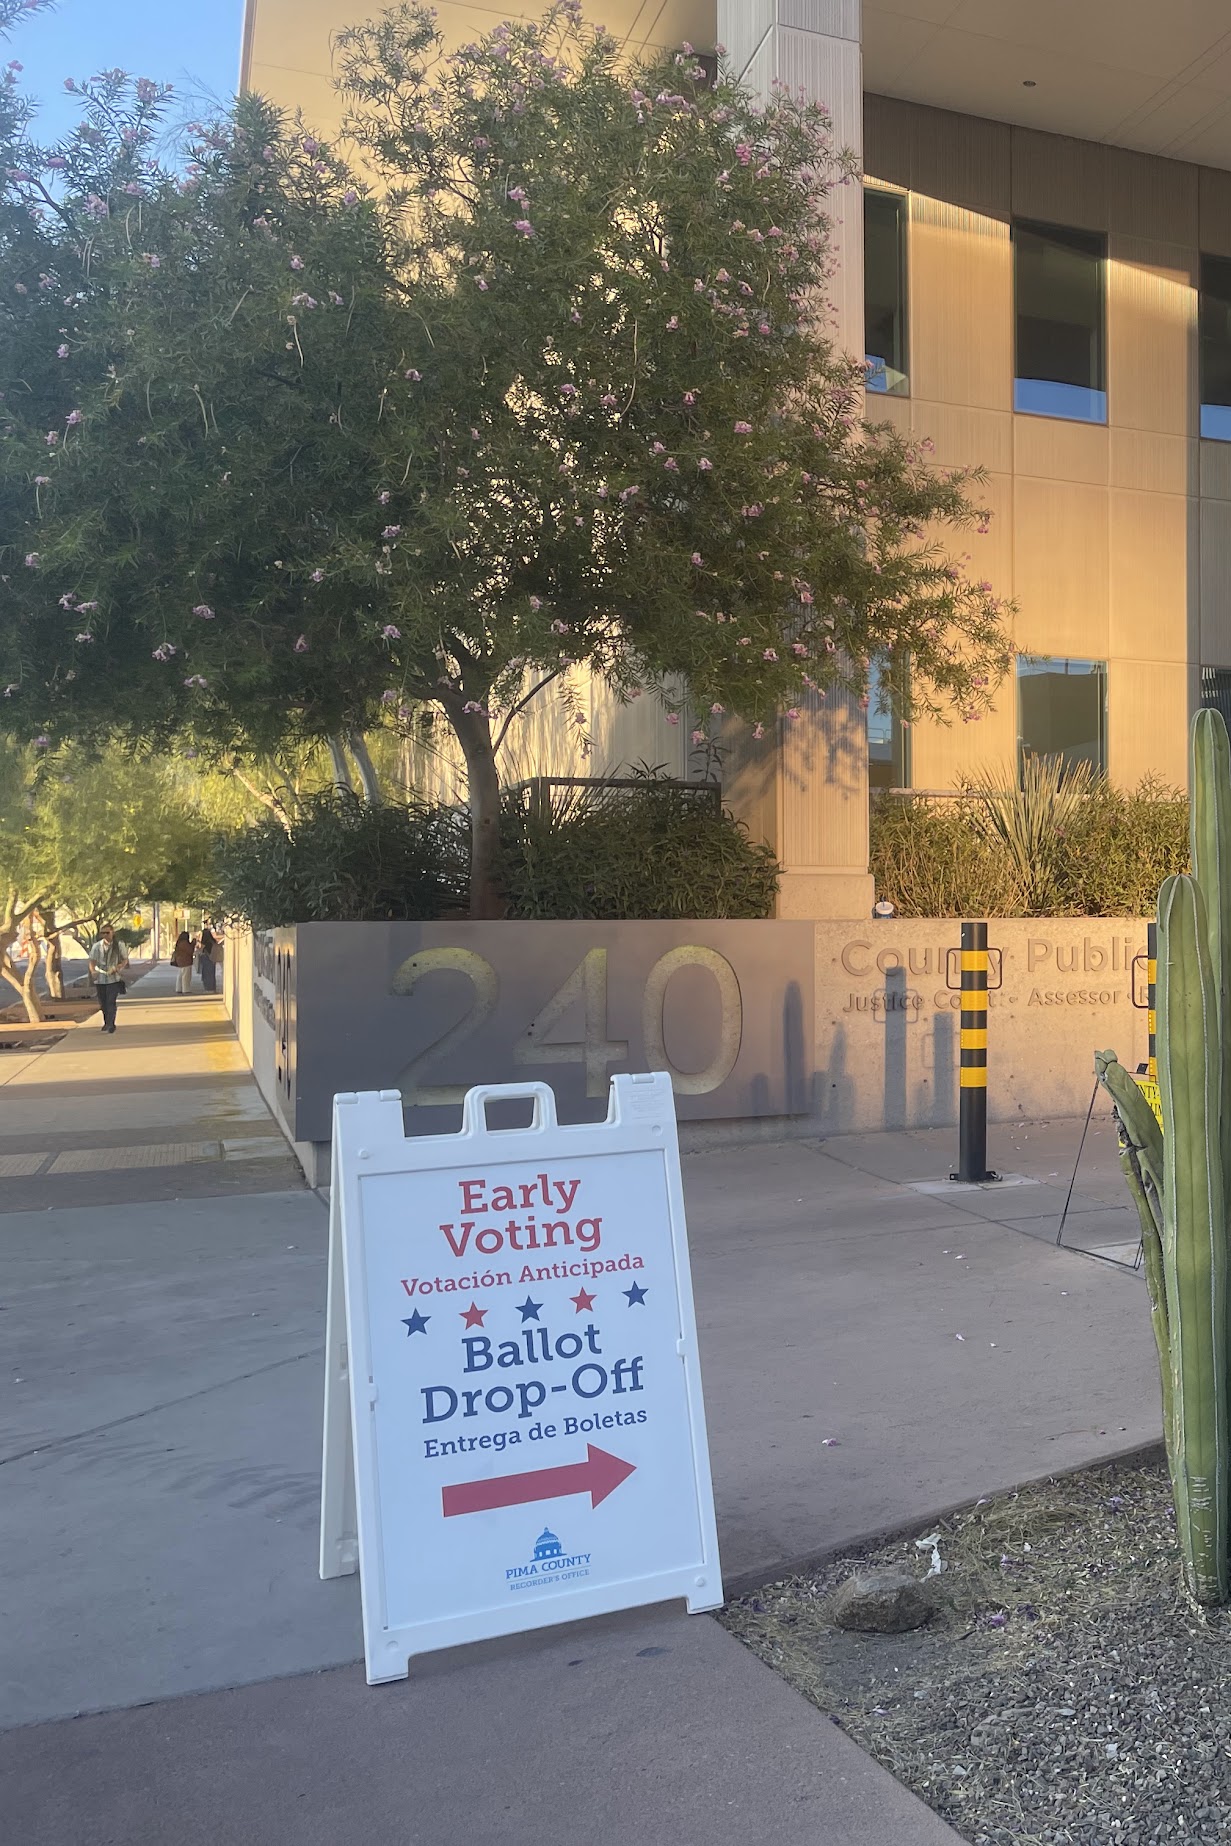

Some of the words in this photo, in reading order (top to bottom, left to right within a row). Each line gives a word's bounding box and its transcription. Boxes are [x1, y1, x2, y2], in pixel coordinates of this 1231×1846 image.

[841, 939, 1010, 981] Couny
[842, 991, 925, 1013] Justice
[933, 989, 998, 1009] Cot
[1027, 987, 1122, 1007] Assessor
[389, 945, 743, 1107] 240
[458, 1173, 581, 1215] Early
[439, 1215, 603, 1257] Voting
[401, 1269, 512, 1297] Votación
[518, 1253, 645, 1283] Anticipada
[461, 1324, 602, 1374] Ballot
[420, 1356, 644, 1424] Drop-Off
[424, 1430, 522, 1459] Entrega
[528, 1422, 557, 1441] de
[563, 1409, 648, 1436] Boletas
[505, 1564, 538, 1580] PIMA
[541, 1553, 592, 1572] COUNTY
[510, 1575, 560, 1591] RECORDER'S
[561, 1568, 590, 1580] OFFICE
